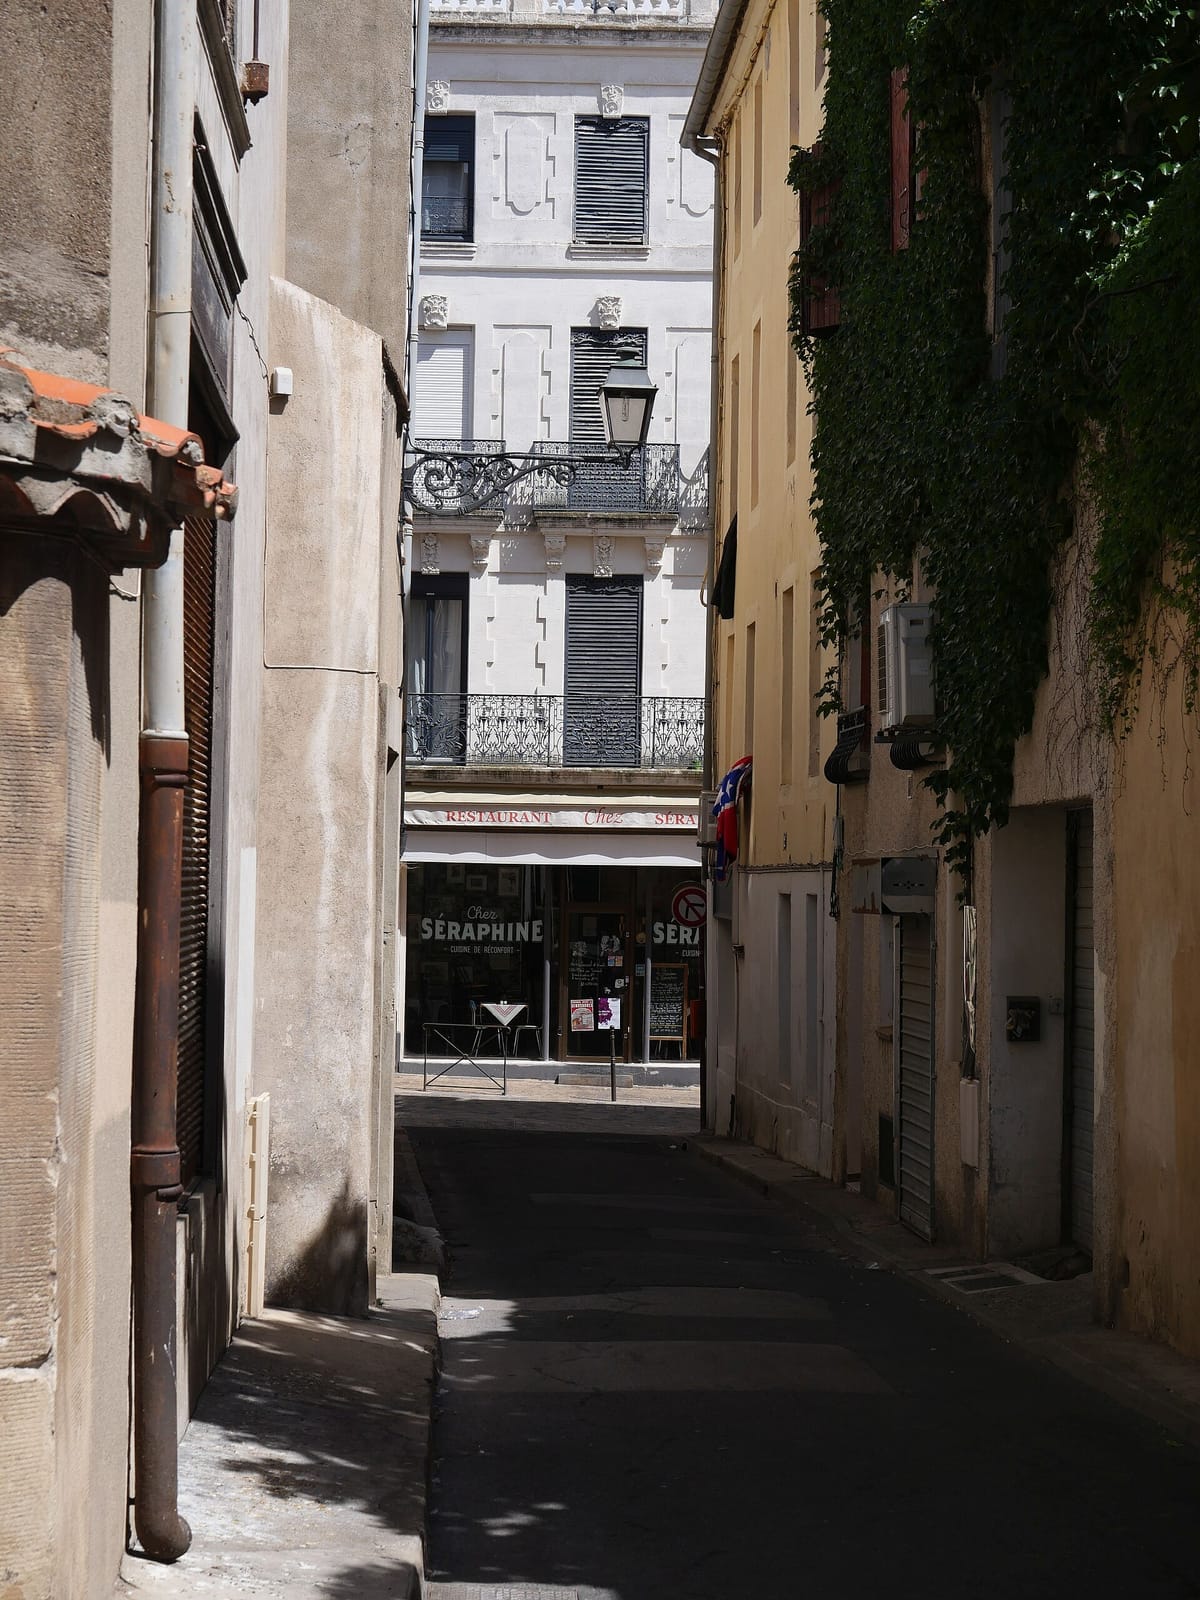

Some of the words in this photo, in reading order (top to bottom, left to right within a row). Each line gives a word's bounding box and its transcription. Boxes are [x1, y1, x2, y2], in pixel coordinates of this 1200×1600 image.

[446, 811, 551, 824] RESTAURANT
[585, 807, 624, 825] Chez
[655, 811, 696, 824] SÉRA
[467, 905, 498, 920] Chez
[421, 913, 544, 942] SÉRAPHINE
[473, 946, 481, 954] DE
